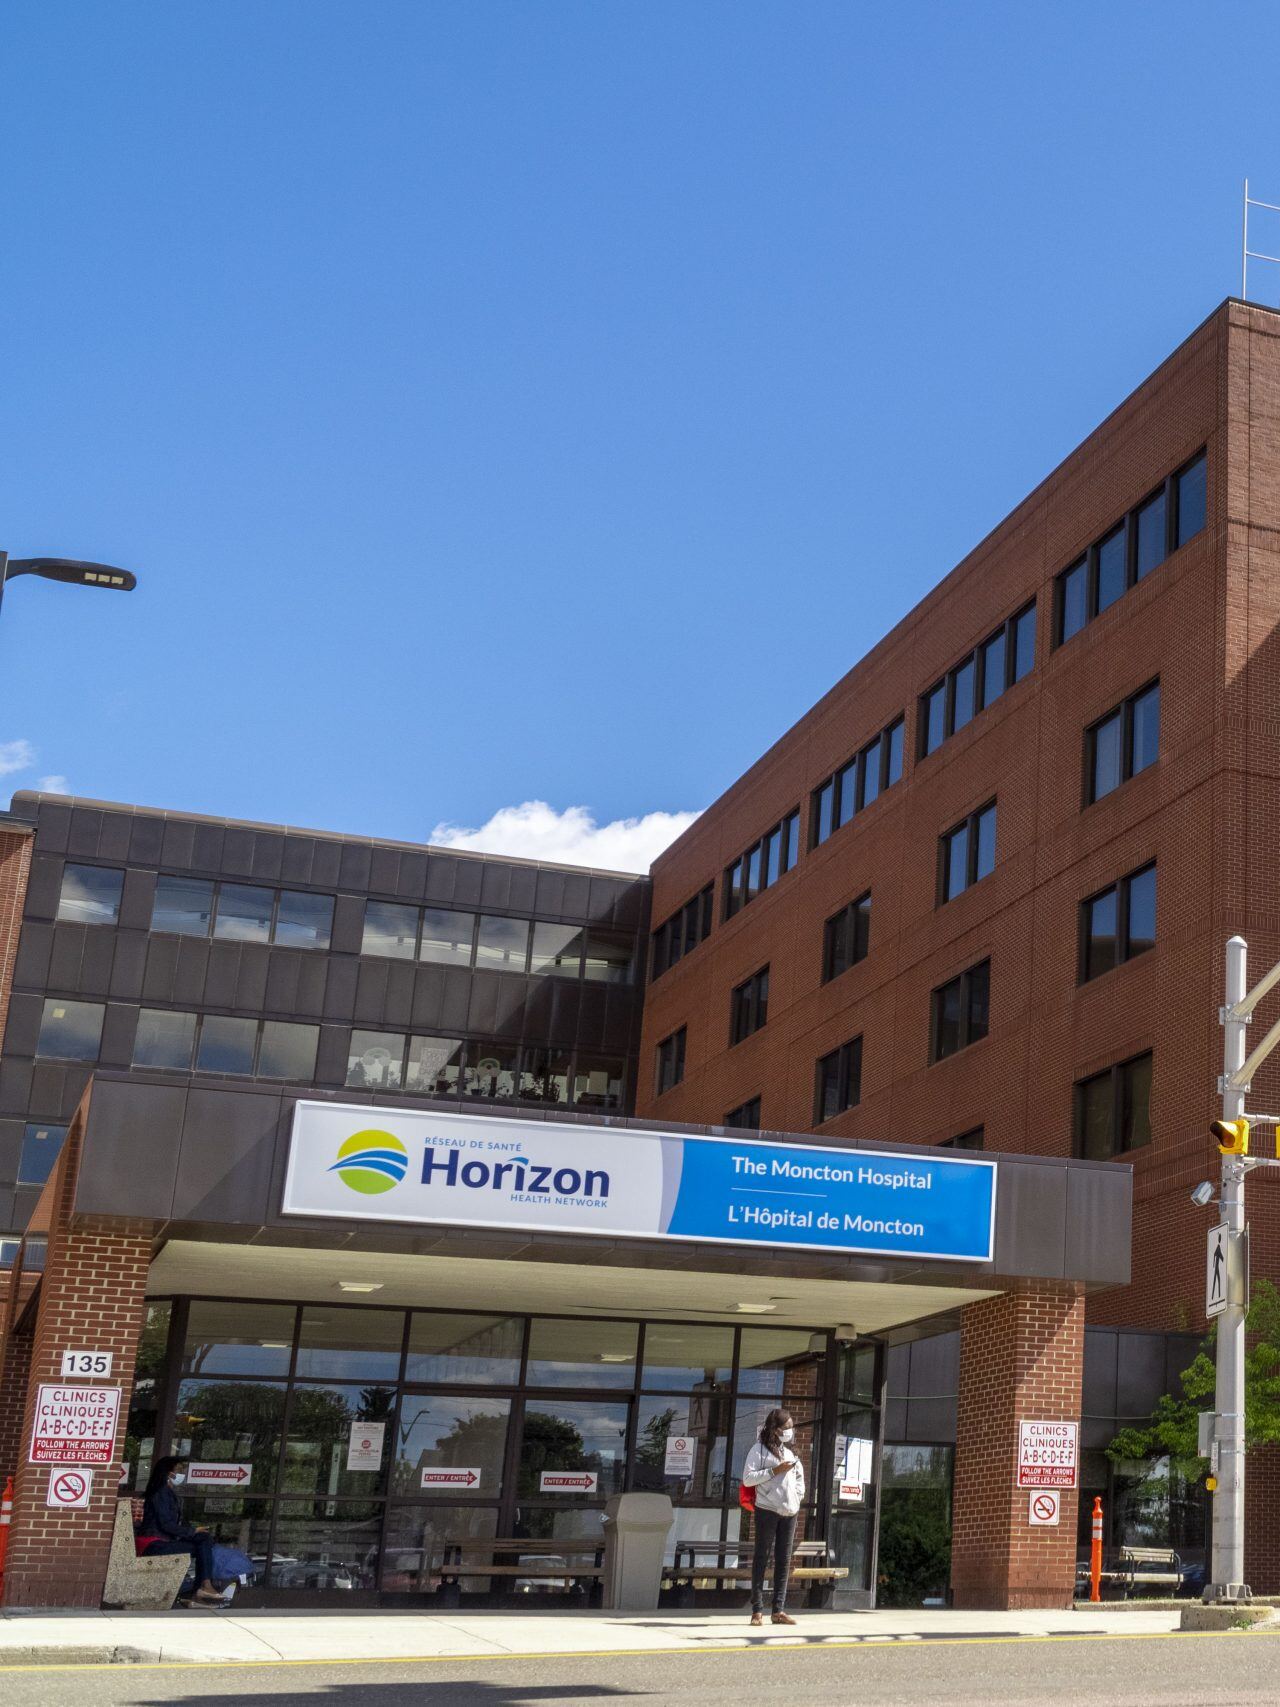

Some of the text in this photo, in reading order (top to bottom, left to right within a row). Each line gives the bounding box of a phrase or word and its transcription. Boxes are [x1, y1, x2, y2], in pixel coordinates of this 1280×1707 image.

[425, 1136, 522, 1152] RÉSEAU DE SANTÉ
[421, 1147, 610, 1197] Horizon
[731, 1156, 931, 1189] The Moncton Hospital
[510, 1193, 608, 1208] HEALTH NETWORK
[728, 1205, 924, 1236] L'Hôpital de Moncton
[67, 1355, 107, 1373] 135
[53, 1391, 106, 1403] CLINICS
[41, 1405, 113, 1418] CLINIQUES
[40, 1419, 112, 1436] A-B-C-D-E-F
[1030, 1425, 1068, 1436] CLINICS
[36, 1440, 110, 1450] FOLLOW THE ARROWS
[1023, 1438, 1074, 1449] CLINIQUES
[36, 1450, 61, 1460] SUIVEZ
[63, 1451, 75, 1460] LES
[1023, 1449, 1073, 1464] A-B-C-D-E-F
[1021, 1467, 1073, 1476] FOLLOW THE ARROWS
[1022, 1476, 1040, 1484] SUIVEZ
[1041, 1476, 1050, 1484] LES
